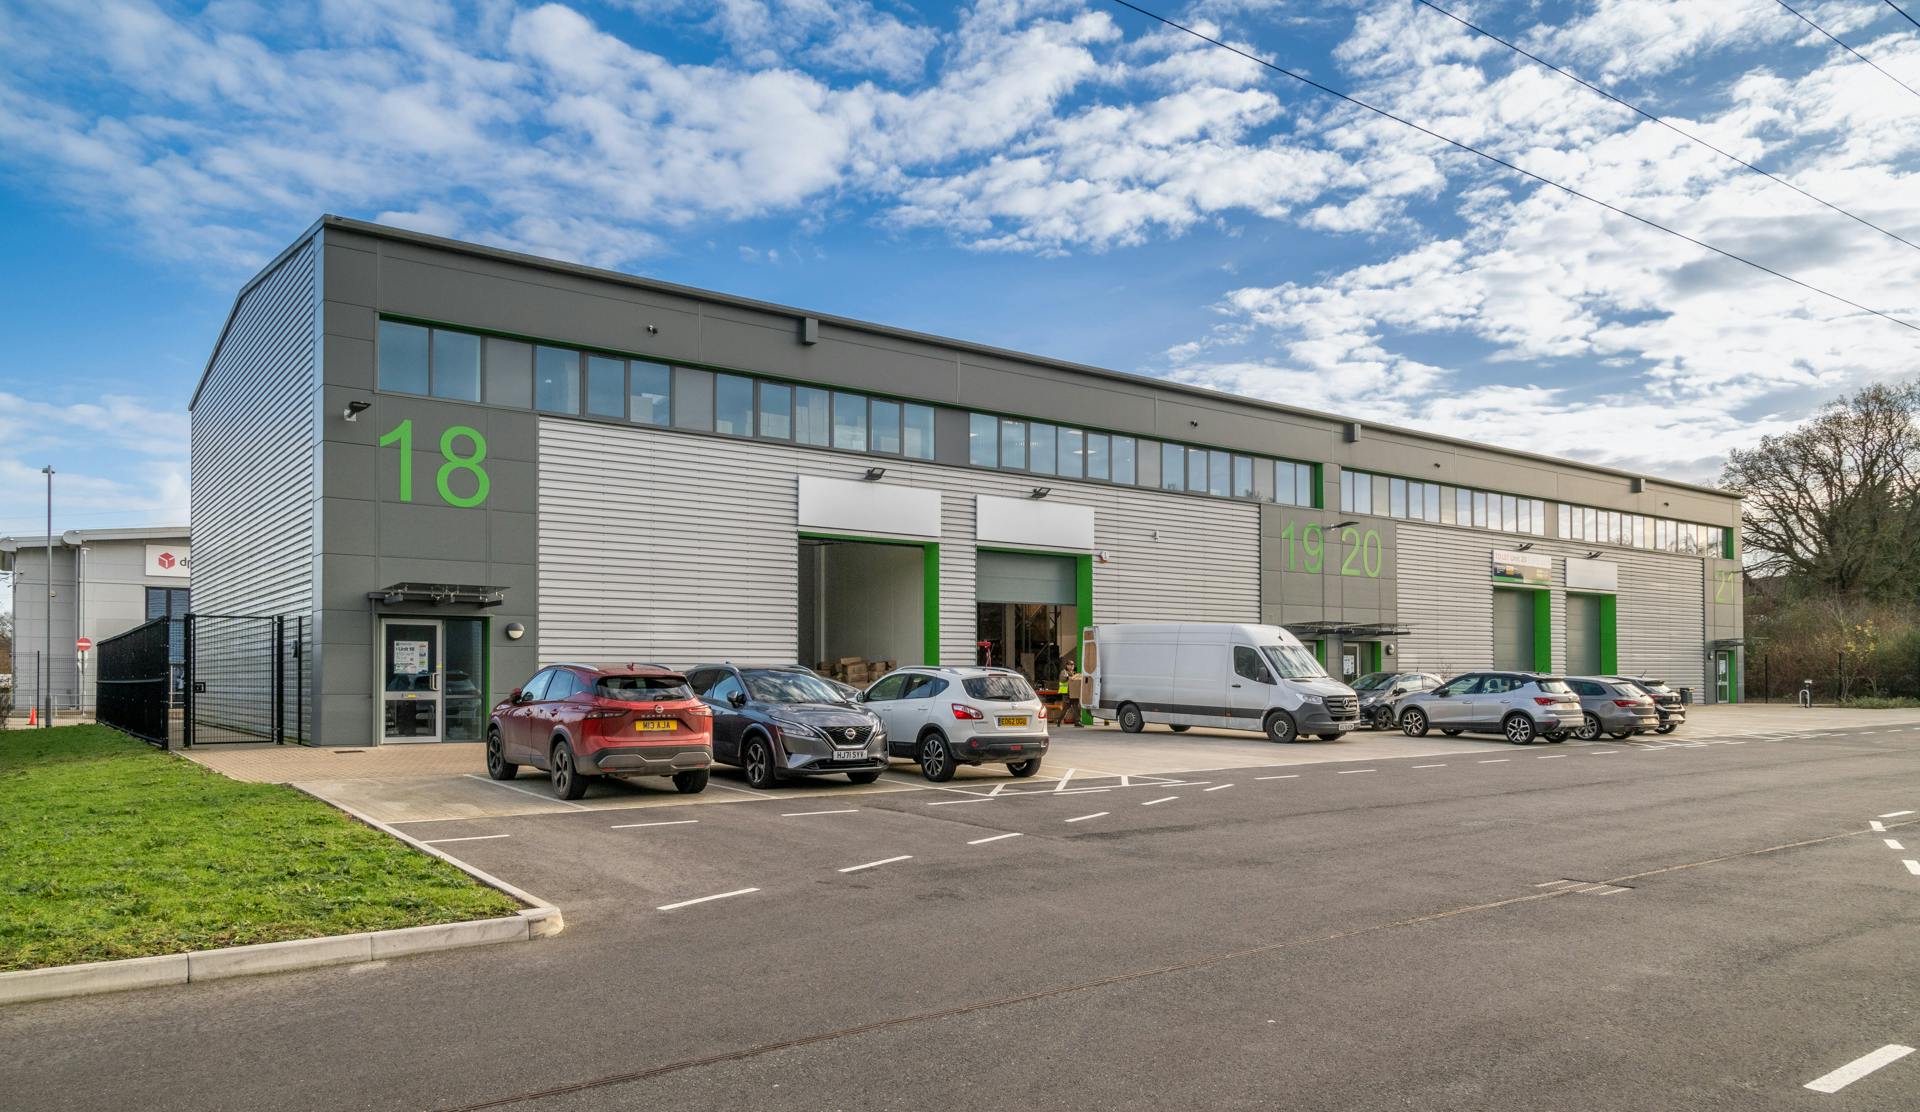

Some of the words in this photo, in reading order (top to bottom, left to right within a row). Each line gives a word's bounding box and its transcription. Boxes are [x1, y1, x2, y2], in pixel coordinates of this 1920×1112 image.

[379, 419, 490, 507] 18
[1281, 520, 1325, 573] 19
[1341, 528, 1382, 577] 20
[1715, 570, 1734, 604] 21
